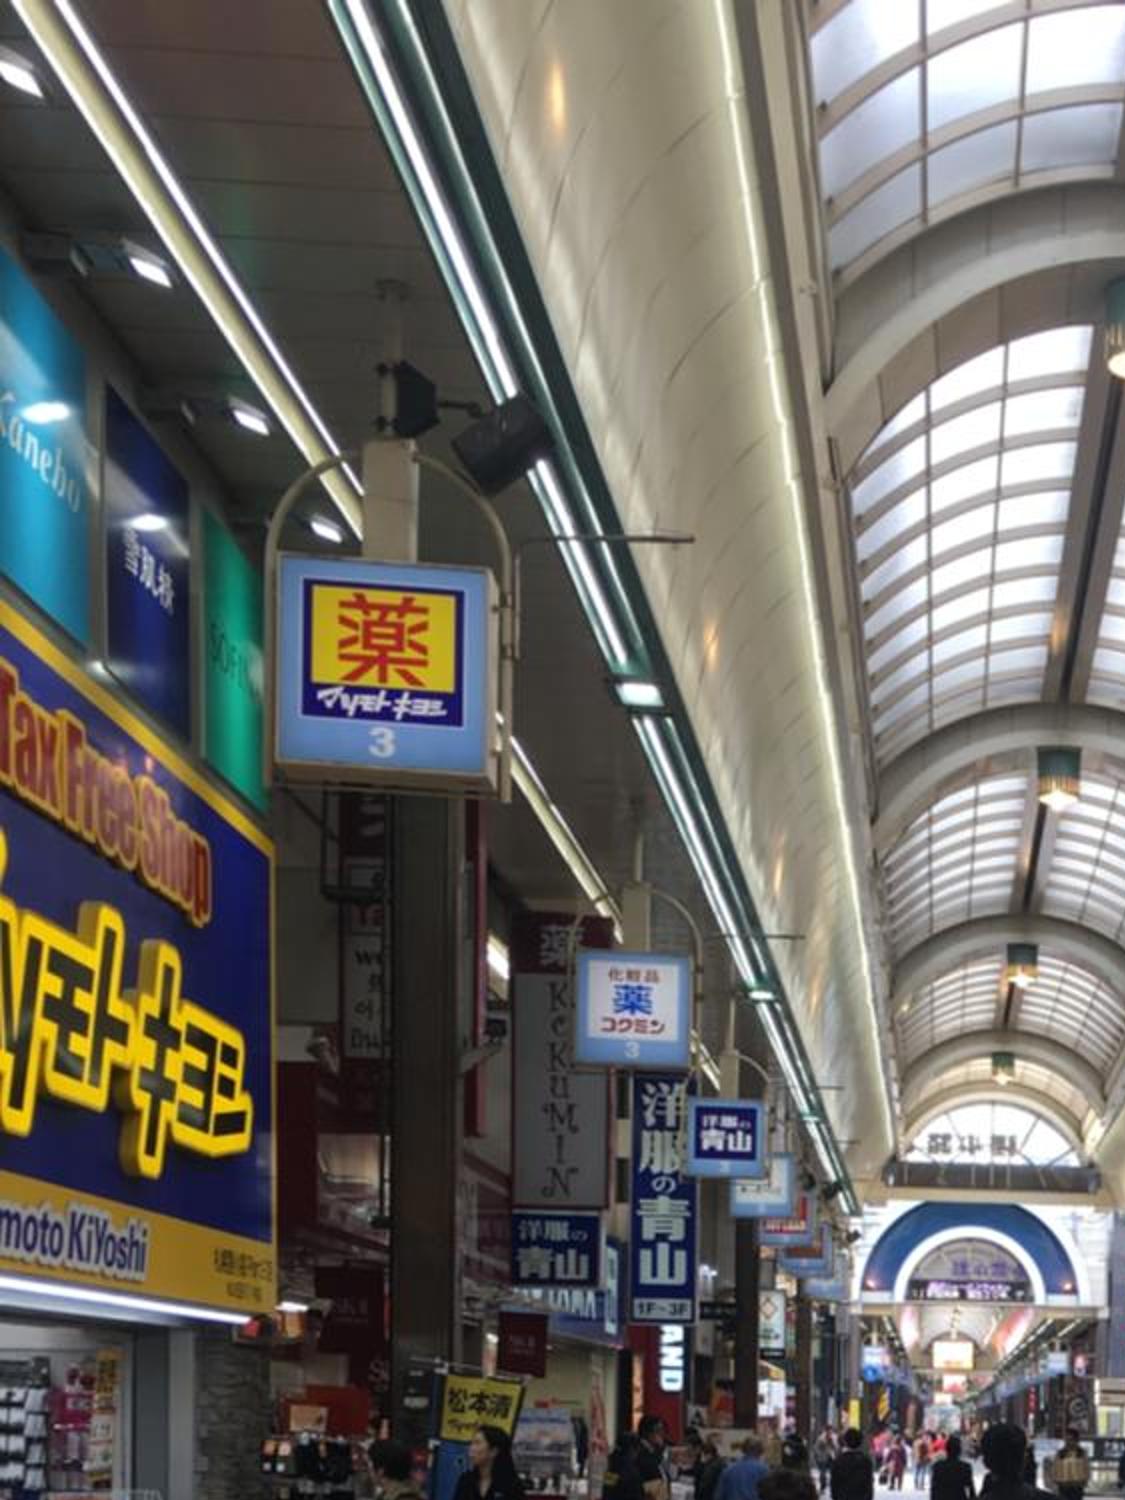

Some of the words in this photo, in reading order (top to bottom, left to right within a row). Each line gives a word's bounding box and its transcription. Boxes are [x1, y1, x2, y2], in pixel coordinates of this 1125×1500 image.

[338, 592, 429, 687] 薬
[317, 685, 448, 720] マツモトキヨシ
[368, 727, 396, 757] 3
[608, 968, 661, 983] 化粧品
[613, 984, 653, 1016] 薬
[601, 1017, 666, 1035] コクミン
[624, 1042, 641, 1059] 3
[700, 1130, 752, 1152] 青山
[516, 1246, 589, 1281] 青山
